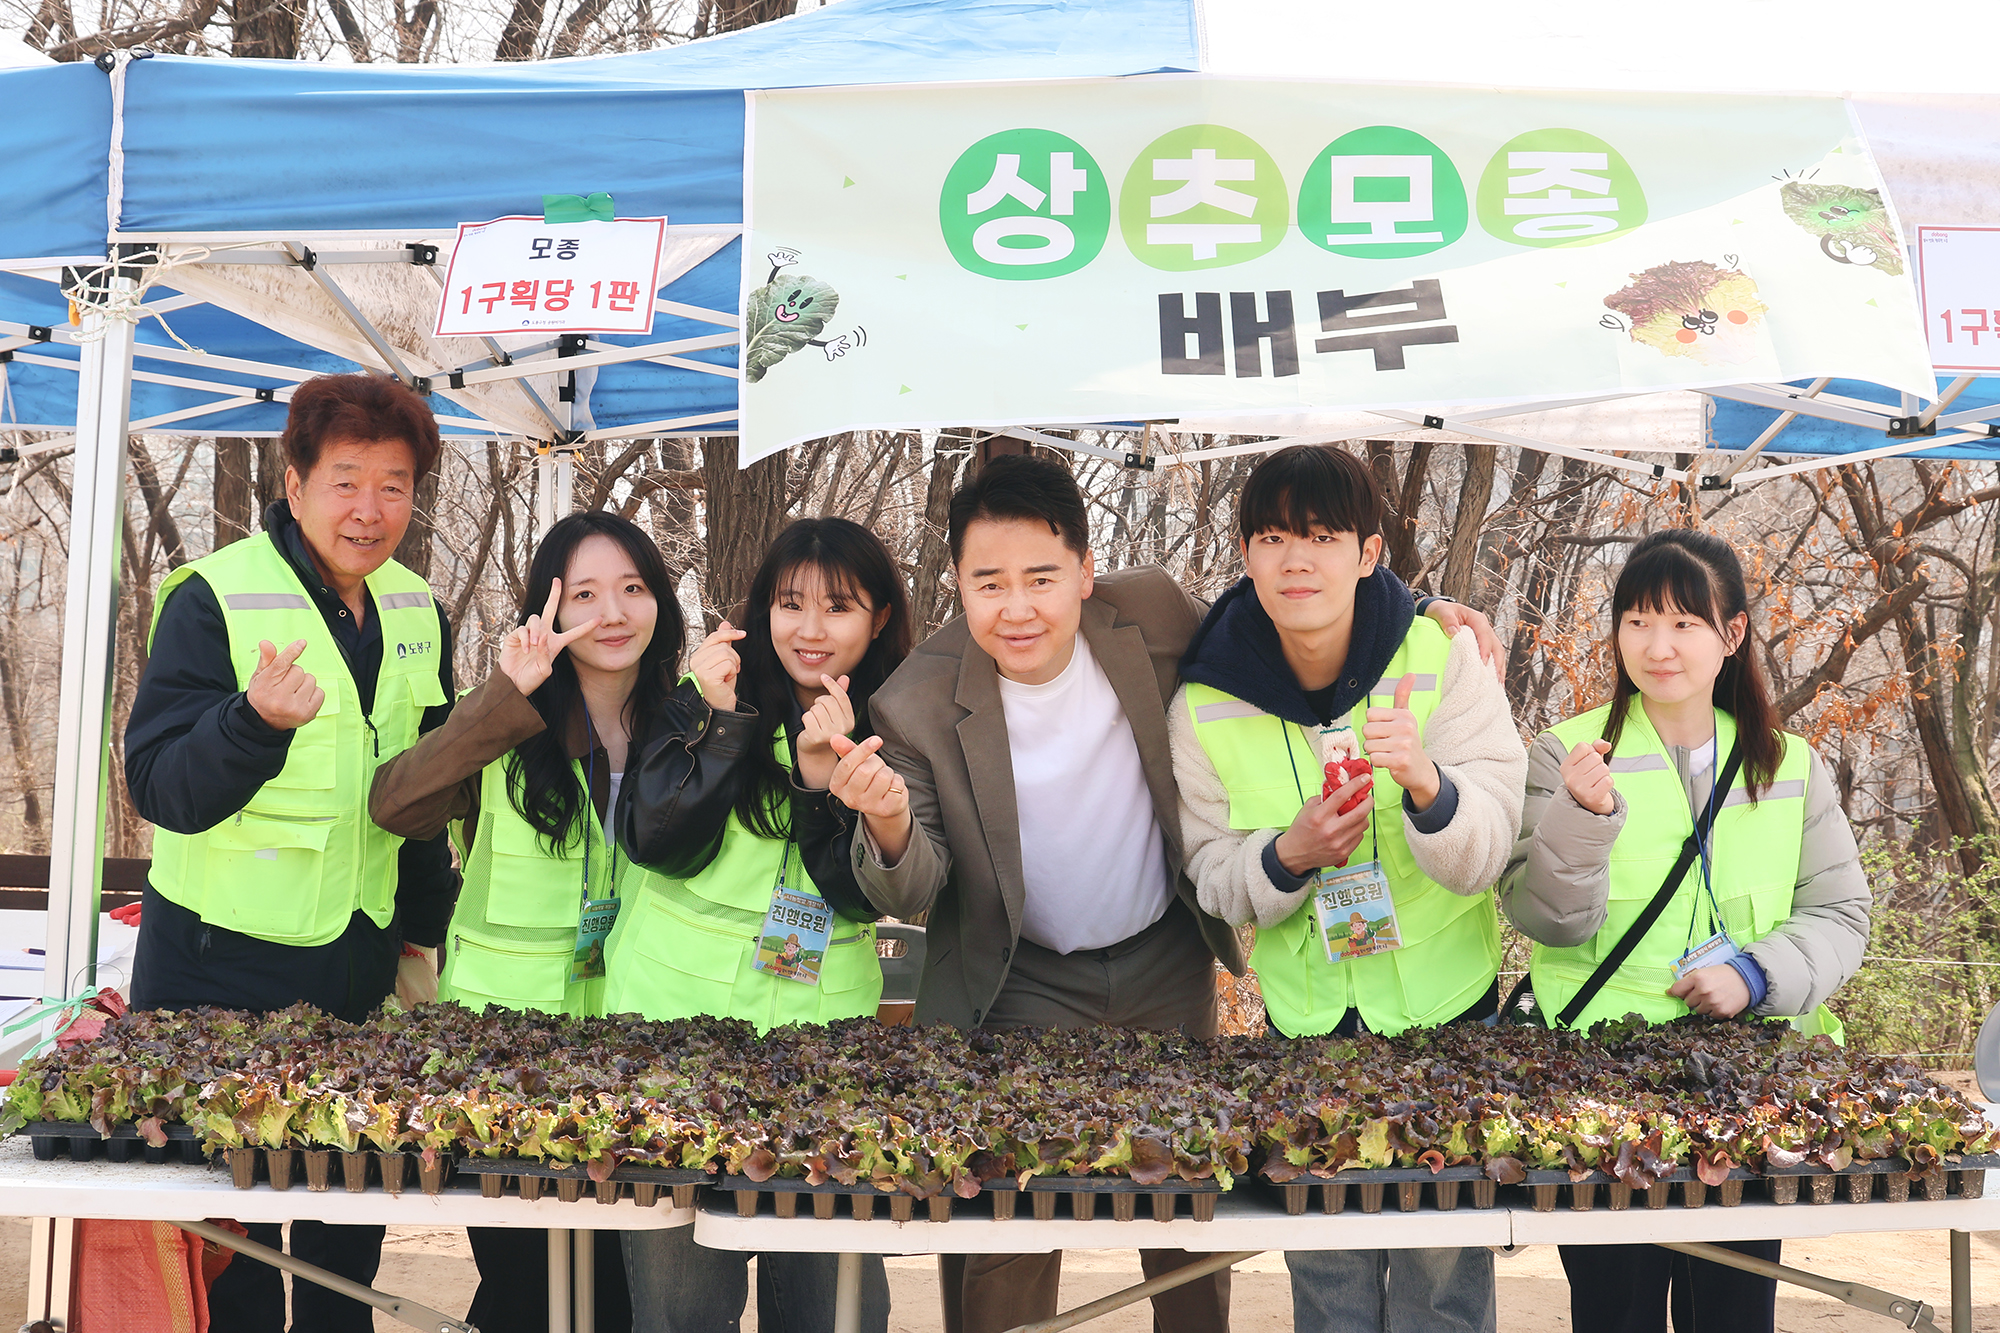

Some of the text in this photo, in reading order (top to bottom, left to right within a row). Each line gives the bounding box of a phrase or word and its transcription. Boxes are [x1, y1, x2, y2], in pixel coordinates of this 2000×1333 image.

[967, 148, 1619, 265] 상추모종
[529, 238, 580, 260] 모종
[461, 279, 640, 314] 1구획당 1판
[1158, 279, 1459, 378] 배부
[1940, 309, 2000, 345] 1구
[409, 641, 431, 654] 도봉구
[1321, 882, 1383, 910] 진행요원
[772, 904, 827, 934] 진행요원
